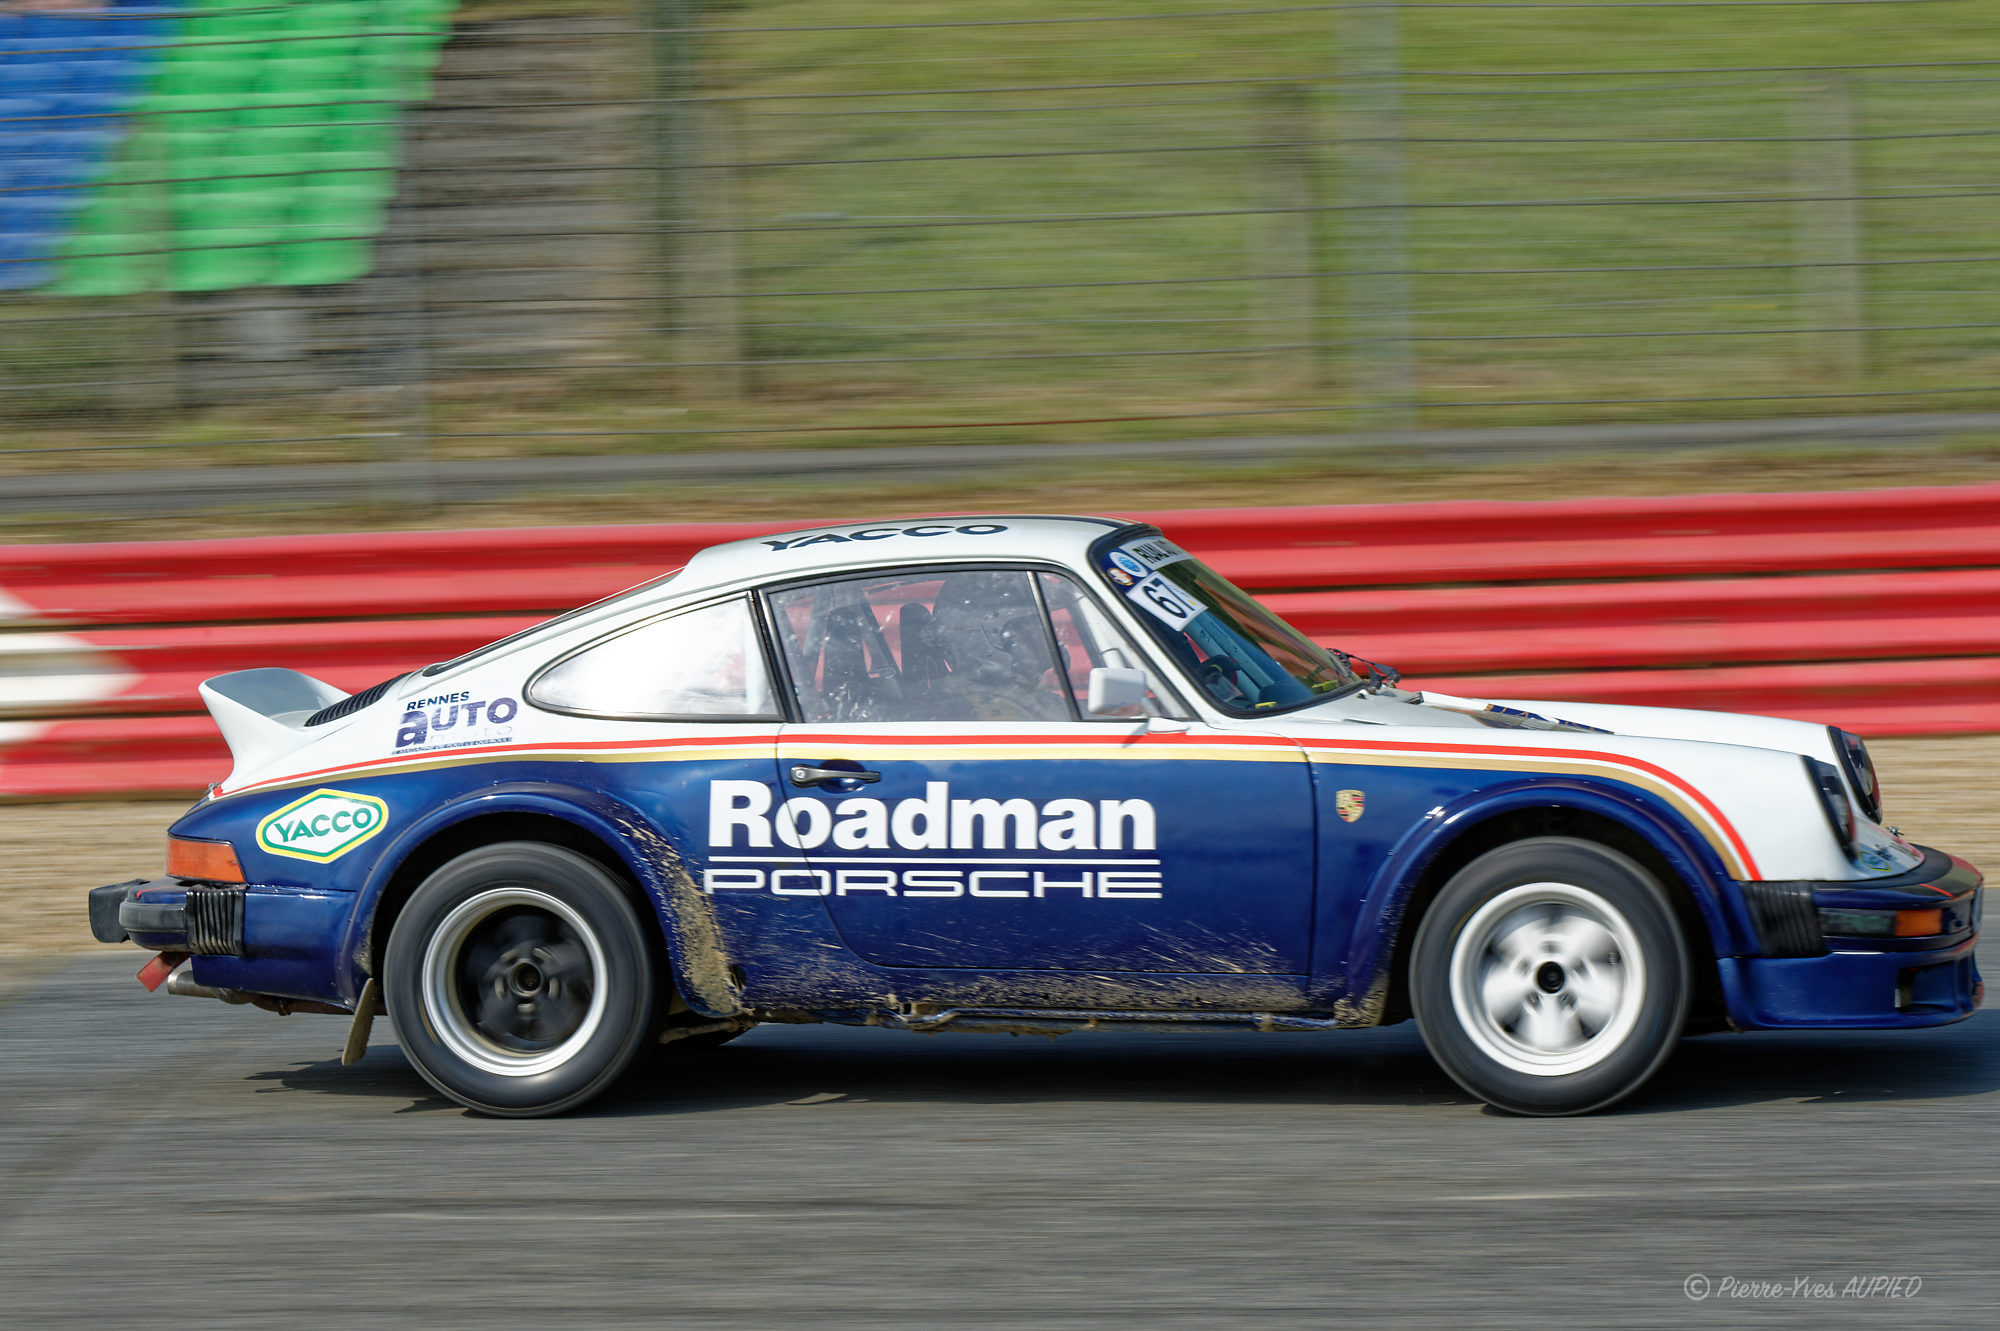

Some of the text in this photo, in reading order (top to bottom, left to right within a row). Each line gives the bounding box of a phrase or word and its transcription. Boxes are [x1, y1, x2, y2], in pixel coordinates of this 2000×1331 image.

[760, 524, 1009, 552] YACCO
[1142, 577, 1196, 619] 67
[406, 691, 470, 711] RENNES
[273, 807, 372, 843] YACCO
[709, 780, 1157, 850] Roadman
[703, 868, 1163, 899] PORSCHE
